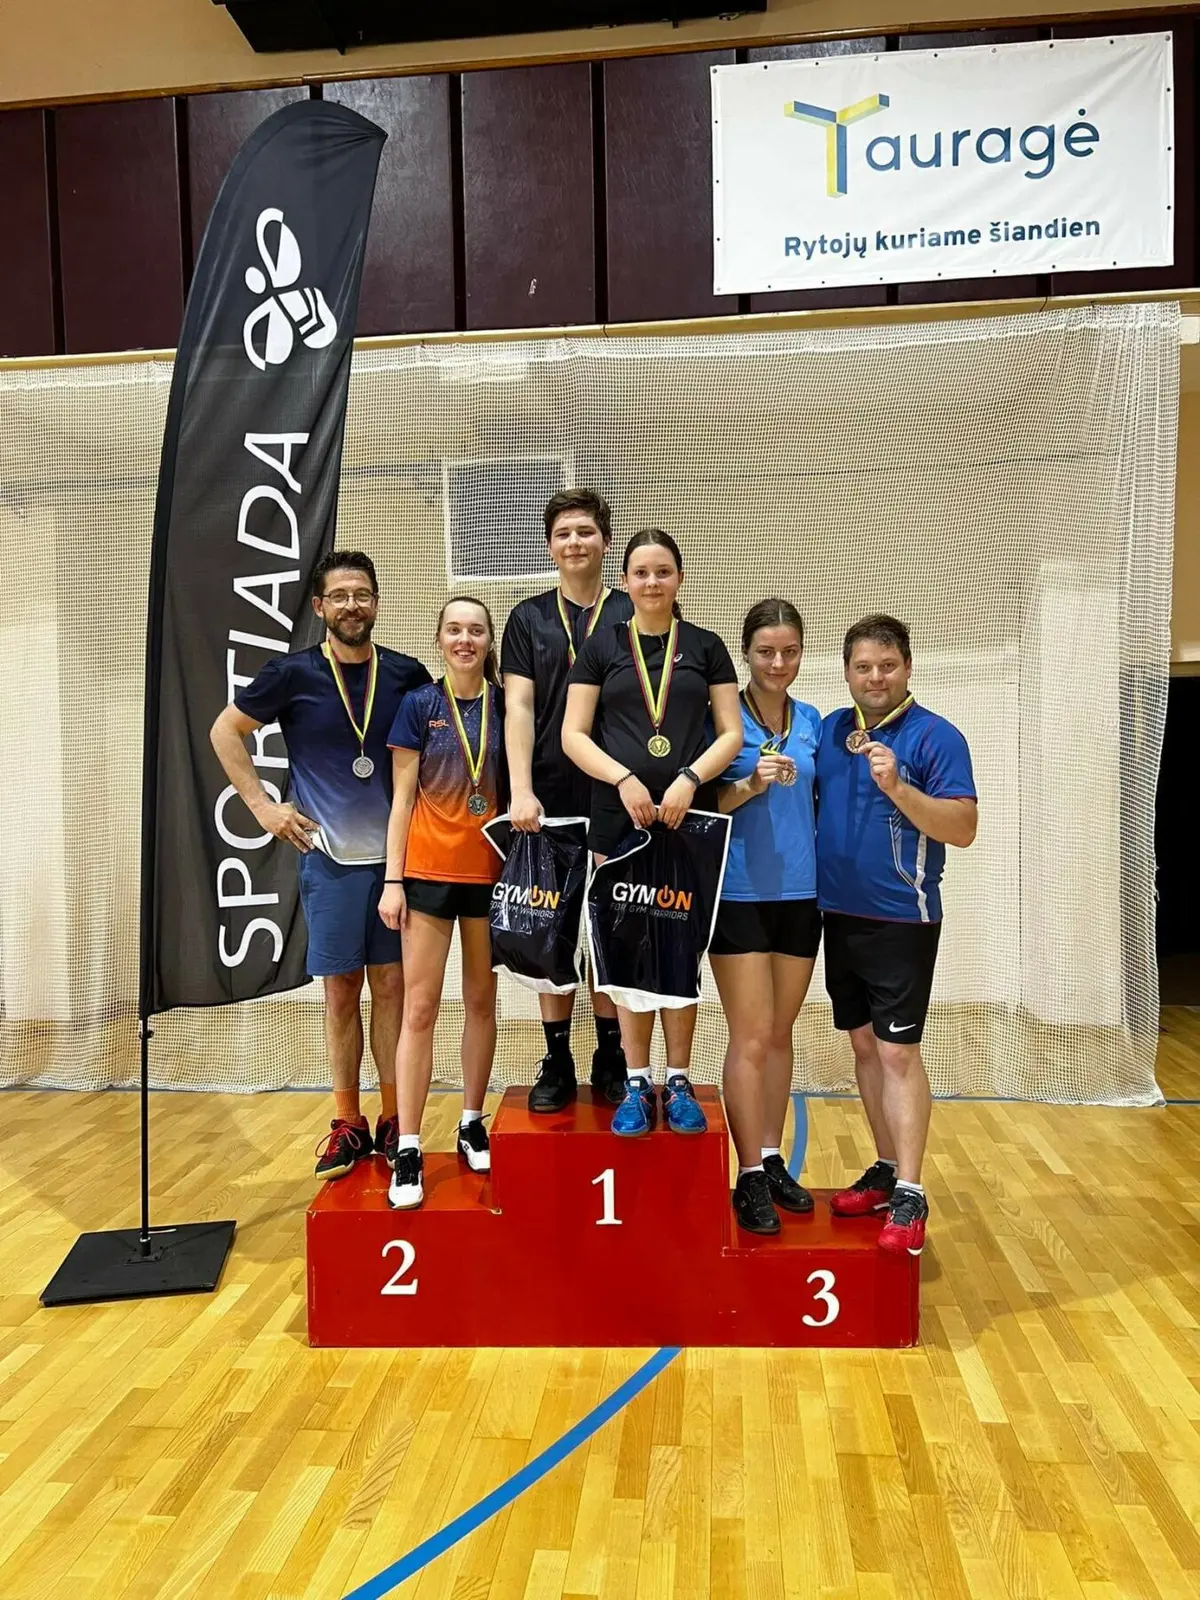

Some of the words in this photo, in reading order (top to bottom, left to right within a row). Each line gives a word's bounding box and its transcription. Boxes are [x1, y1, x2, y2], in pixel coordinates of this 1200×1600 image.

[784, 93, 1100, 198] Tauragė
[784, 232, 867, 261] Rytojų
[876, 227, 981, 251] kuriame
[990, 217, 1100, 243] šiandien
[428, 719, 450, 728] RSL
[612, 881, 693, 911] GYMON
[629, 904, 648, 914] GYM
[591, 1168, 623, 1226] 1
[380, 1239, 419, 1295] 2
[801, 1269, 840, 1327] 3
